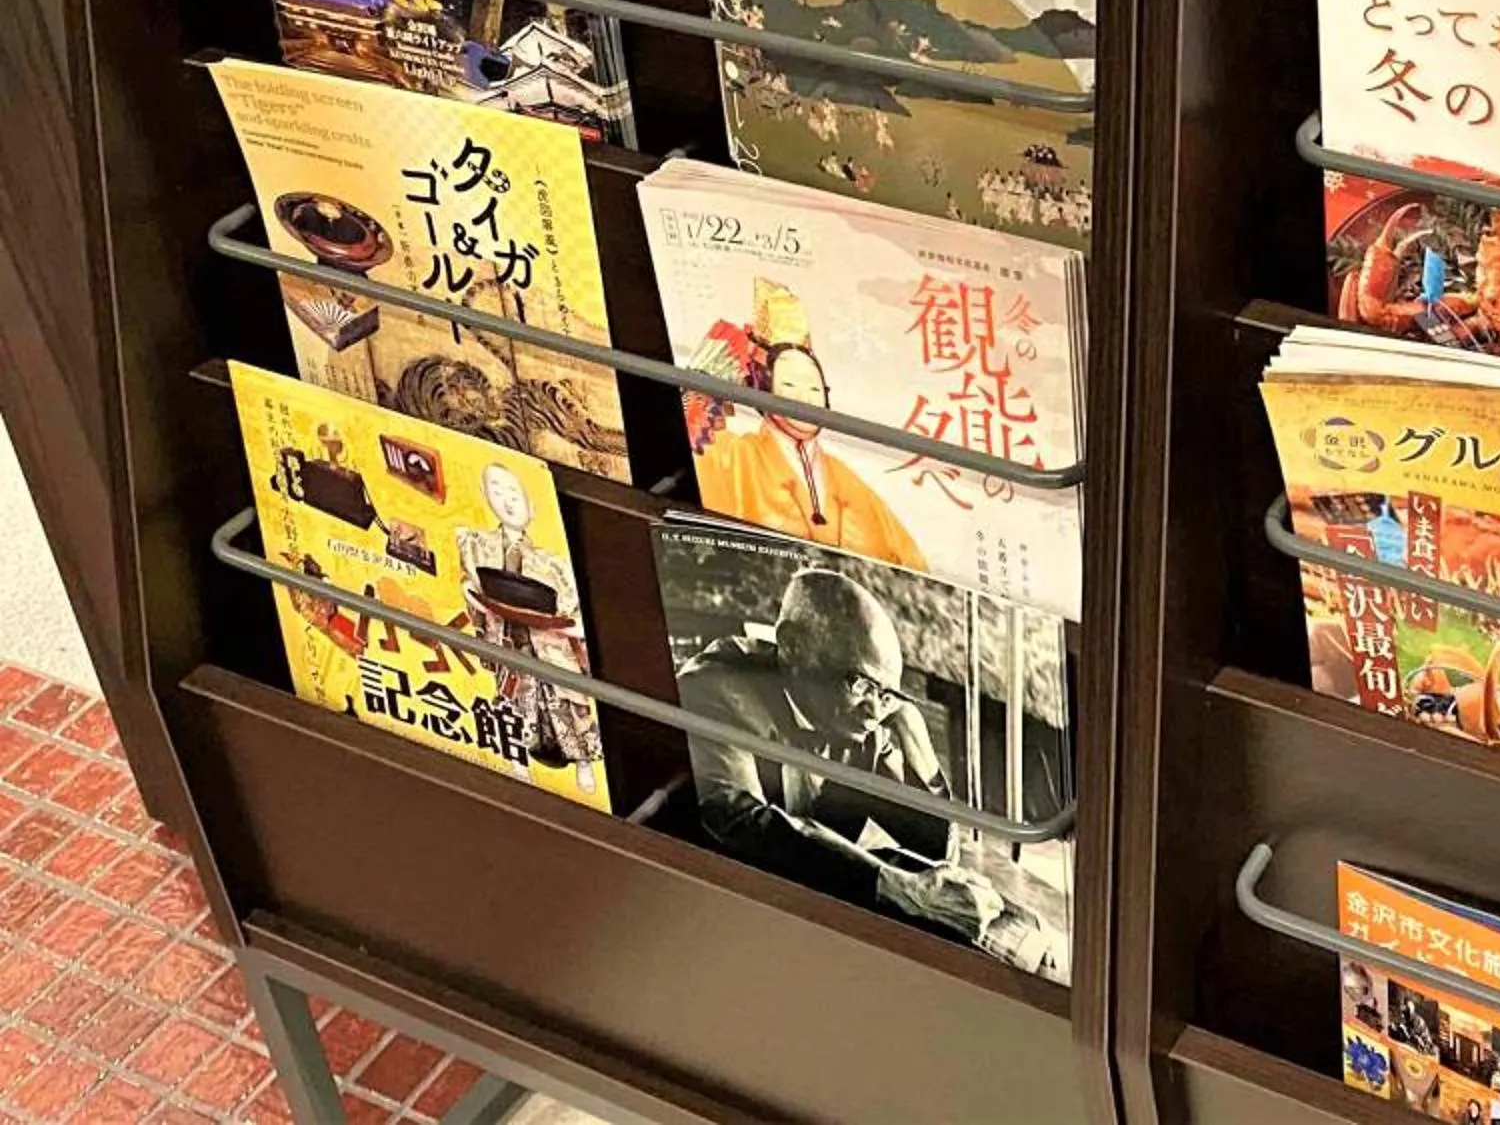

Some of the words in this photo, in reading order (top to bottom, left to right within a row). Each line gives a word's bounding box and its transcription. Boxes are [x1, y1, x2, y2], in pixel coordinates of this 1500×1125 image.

[311, 92, 364, 113] screen
[453, 136, 540, 324] タイガー
[1005, 293, 1042, 362] 冬の
[1409, 495, 1441, 621] いま食べい
[357, 655, 532, 767] 記念館
